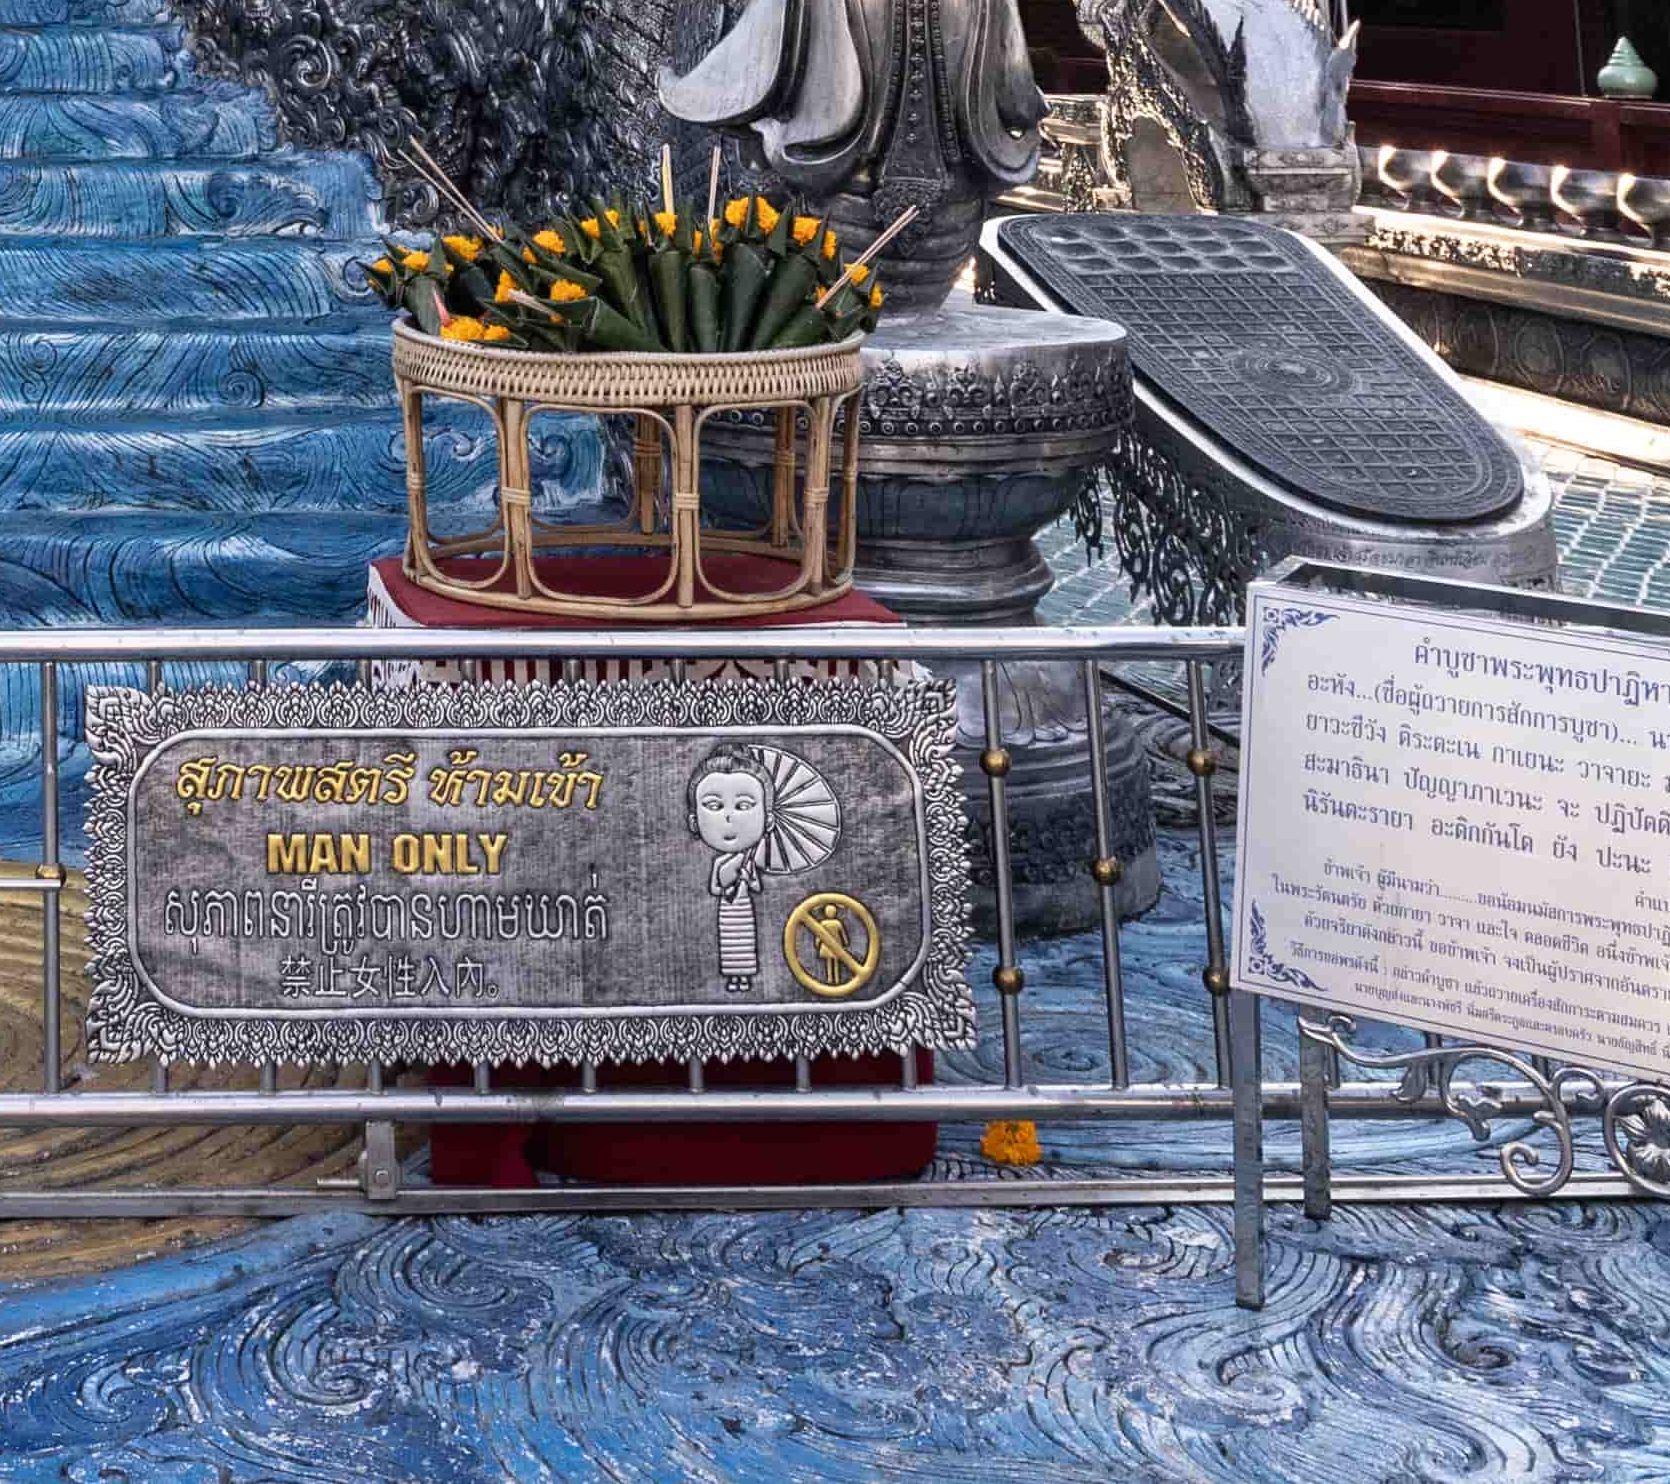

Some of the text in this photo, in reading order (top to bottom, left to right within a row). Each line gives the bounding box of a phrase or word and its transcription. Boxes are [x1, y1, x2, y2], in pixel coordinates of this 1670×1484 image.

[175, 750, 604, 816] สุภาพสตรี ห้ามเข้า
[1304, 712, 1387, 744] ยาวะชีวัง
[1490, 744, 1565, 774] กาเยนะ
[1575, 759, 1652, 789] วาจายะ
[1302, 751, 1389, 786] สะมาธินา
[1555, 797, 1581, 818] จะ
[266, 832, 509, 875] MAN ONLY
[1551, 833, 1578, 863] ยัง
[1594, 845, 1652, 875] ปะนะ
